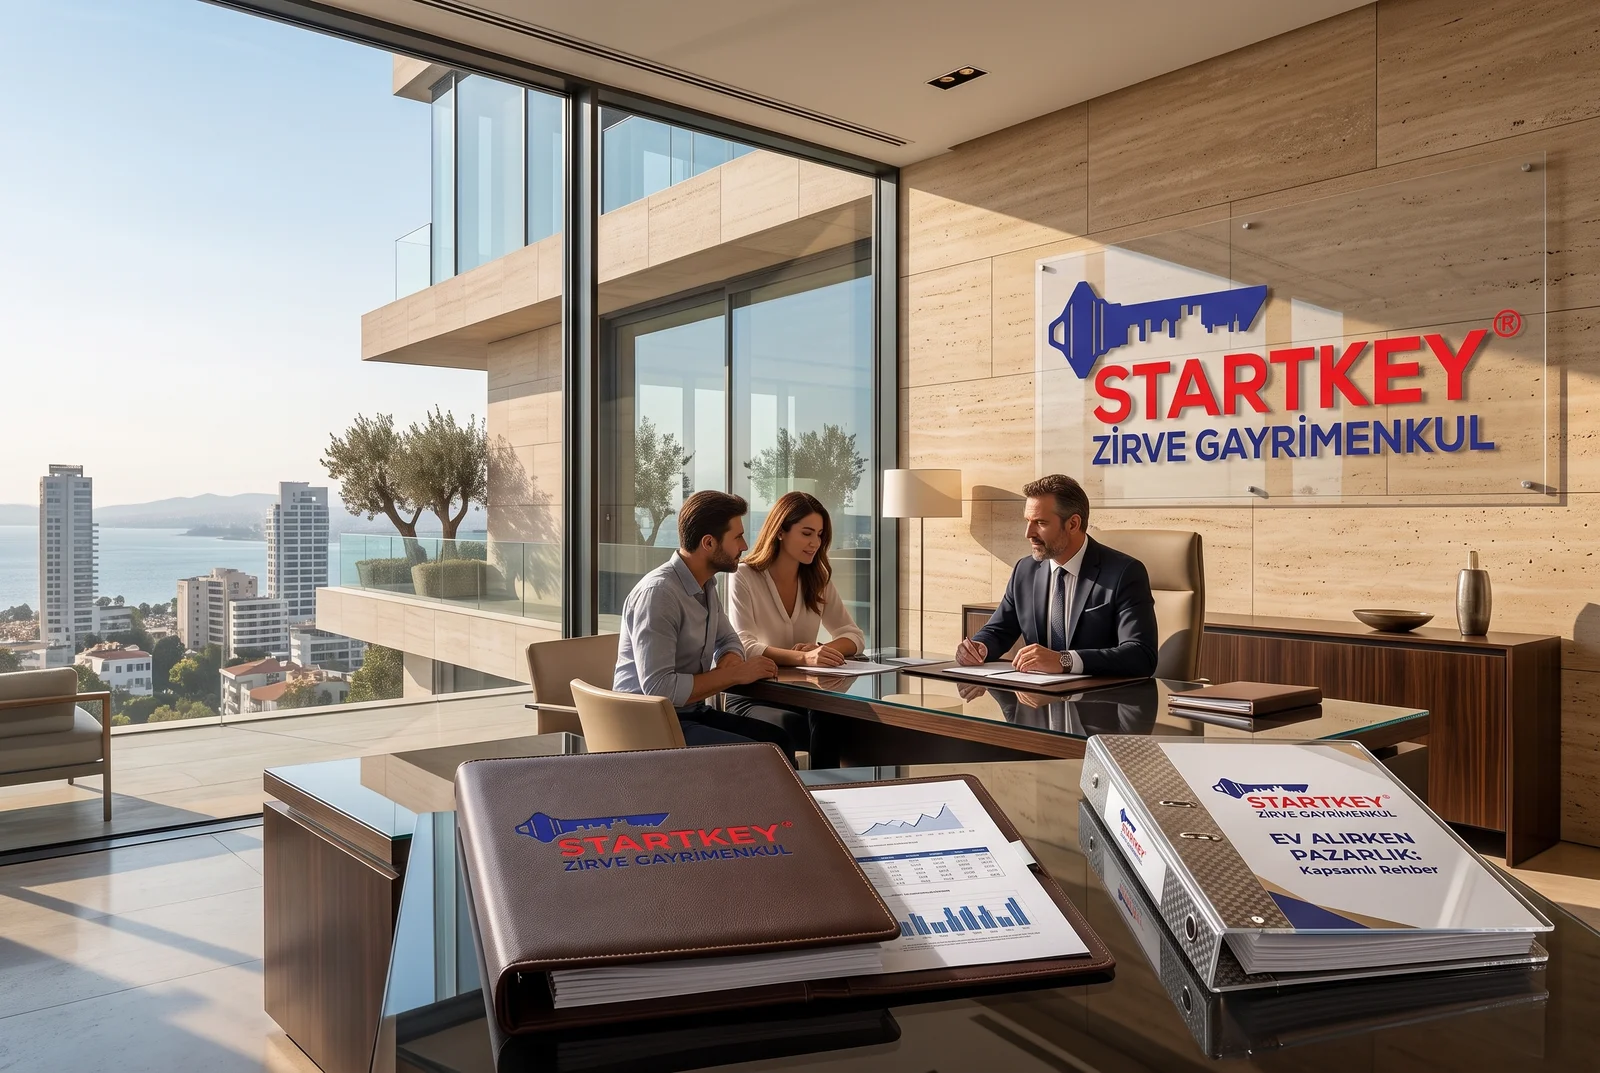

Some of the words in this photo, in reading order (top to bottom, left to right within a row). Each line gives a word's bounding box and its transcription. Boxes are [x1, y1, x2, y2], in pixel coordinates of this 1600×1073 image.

[1093, 329, 1487, 424] STARTKEY
[1092, 425, 1186, 465] ZİRVE
[1195, 414, 1495, 461] GAYRİMENKUL
[1256, 808, 1298, 819] ZİRVE
[1299, 808, 1398, 818] GAYRİMENKUL
[557, 823, 779, 857] STARTKEY
[1268, 832, 1301, 845] EV
[1312, 832, 1416, 845] ALIRKEN
[563, 856, 629, 872] ZİRVE
[634, 843, 794, 867] GAYRİMENKUL
[1289, 849, 1423, 861] PAZARLIK:
[1299, 864, 1377, 877] Kapsamlı
[1379, 864, 1439, 875] Rehber
